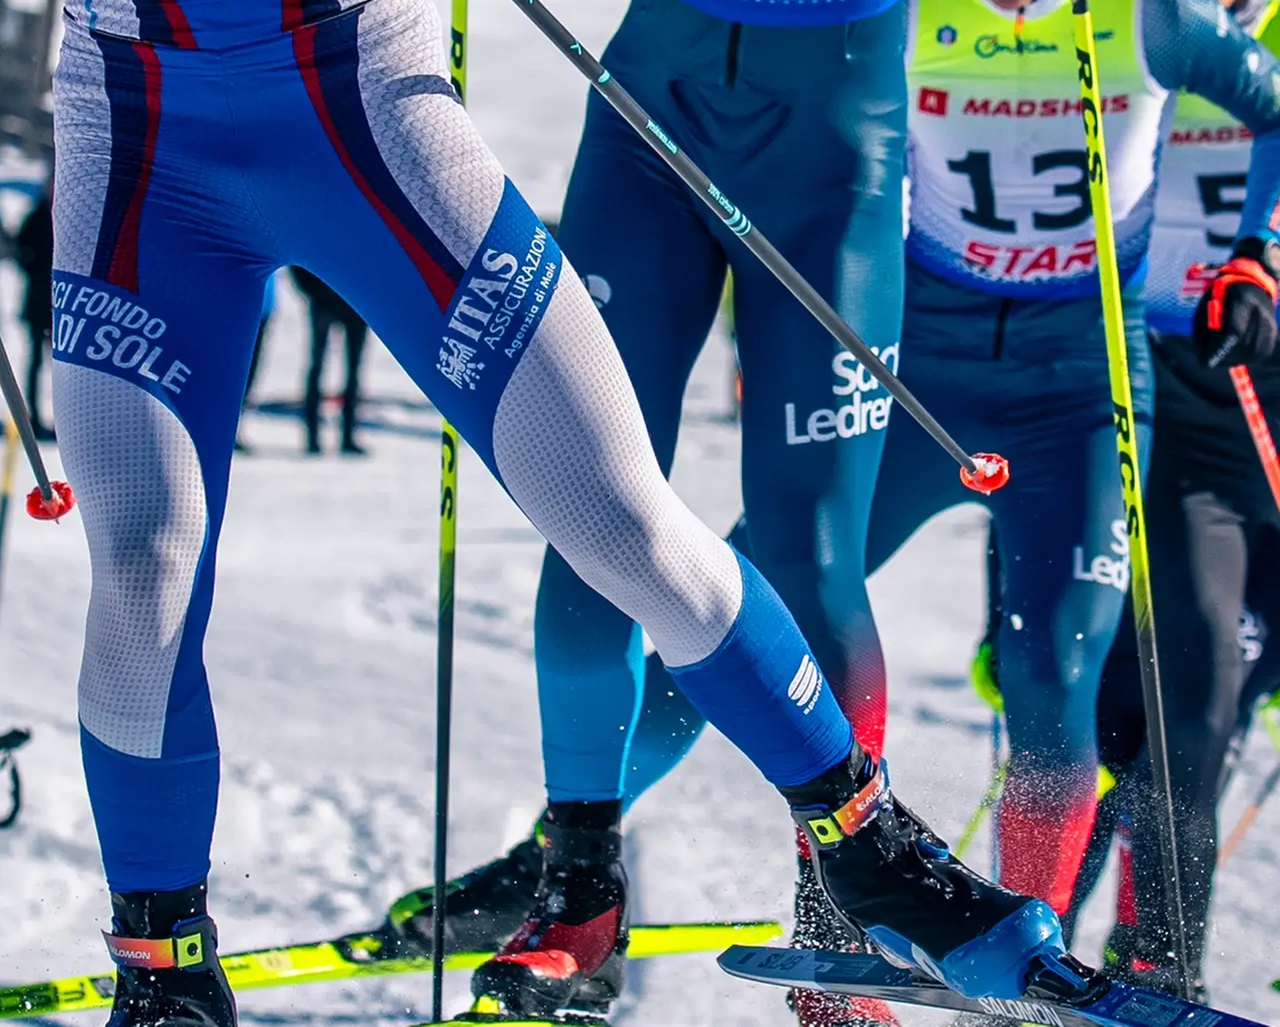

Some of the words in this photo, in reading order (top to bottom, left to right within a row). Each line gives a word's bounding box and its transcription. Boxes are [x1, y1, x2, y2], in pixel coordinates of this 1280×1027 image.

[1076, 47, 1103, 185] RCS
[947, 149, 1094, 234] 13
[71, 286, 167, 340] FONDO
[448, 249, 518, 342] ITAS
[484, 226, 547, 350] ASSICURAZIONI
[504, 305, 539, 359] Agenzia
[536, 286, 546, 303] di
[86, 325, 192, 394] SOLE
[1112, 403, 1140, 539] RCS
[978, 997, 1063, 1026] SALOMON
